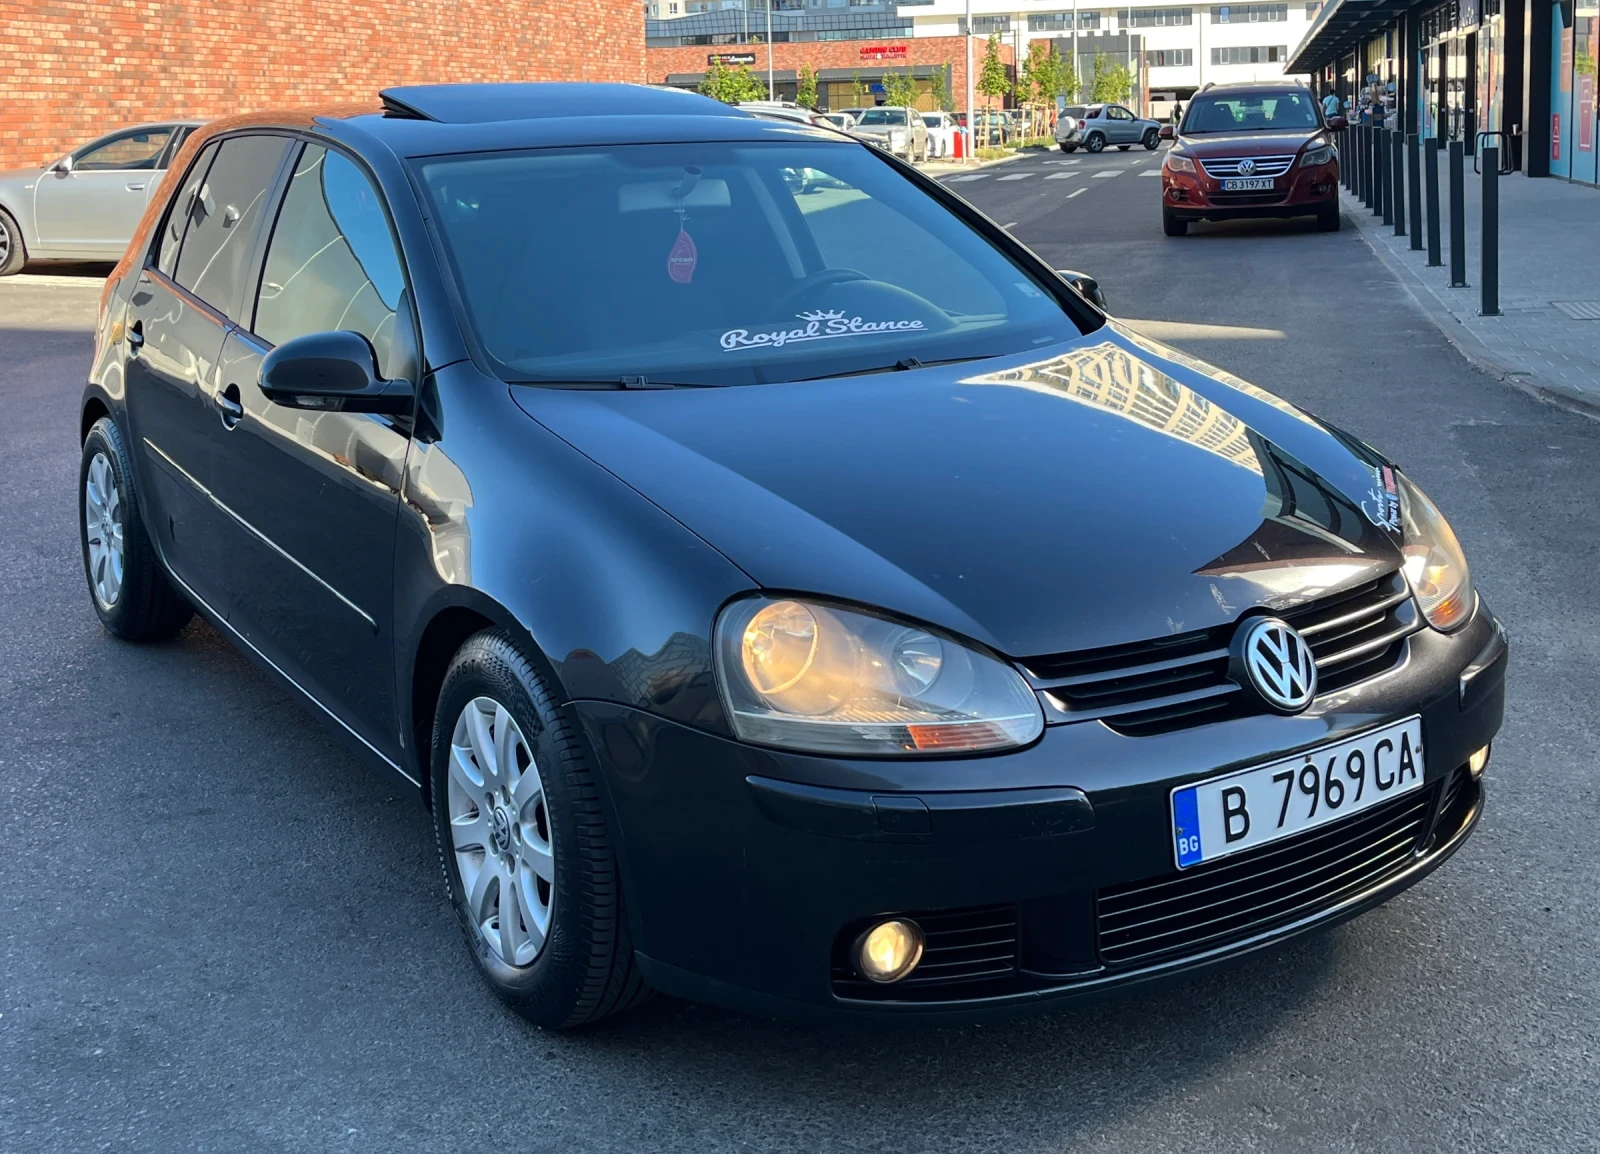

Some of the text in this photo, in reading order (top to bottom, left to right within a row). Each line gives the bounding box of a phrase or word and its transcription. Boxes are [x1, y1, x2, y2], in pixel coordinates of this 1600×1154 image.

[1226, 181, 1238, 190] CB
[1239, 180, 1260, 189] 3197
[1261, 180, 1273, 188] XT
[719, 316, 925, 348] Royal Stance
[1247, 618, 1317, 707] VW
[1221, 730, 1417, 843] B 7969 CA
[1178, 834, 1199, 856] BG
